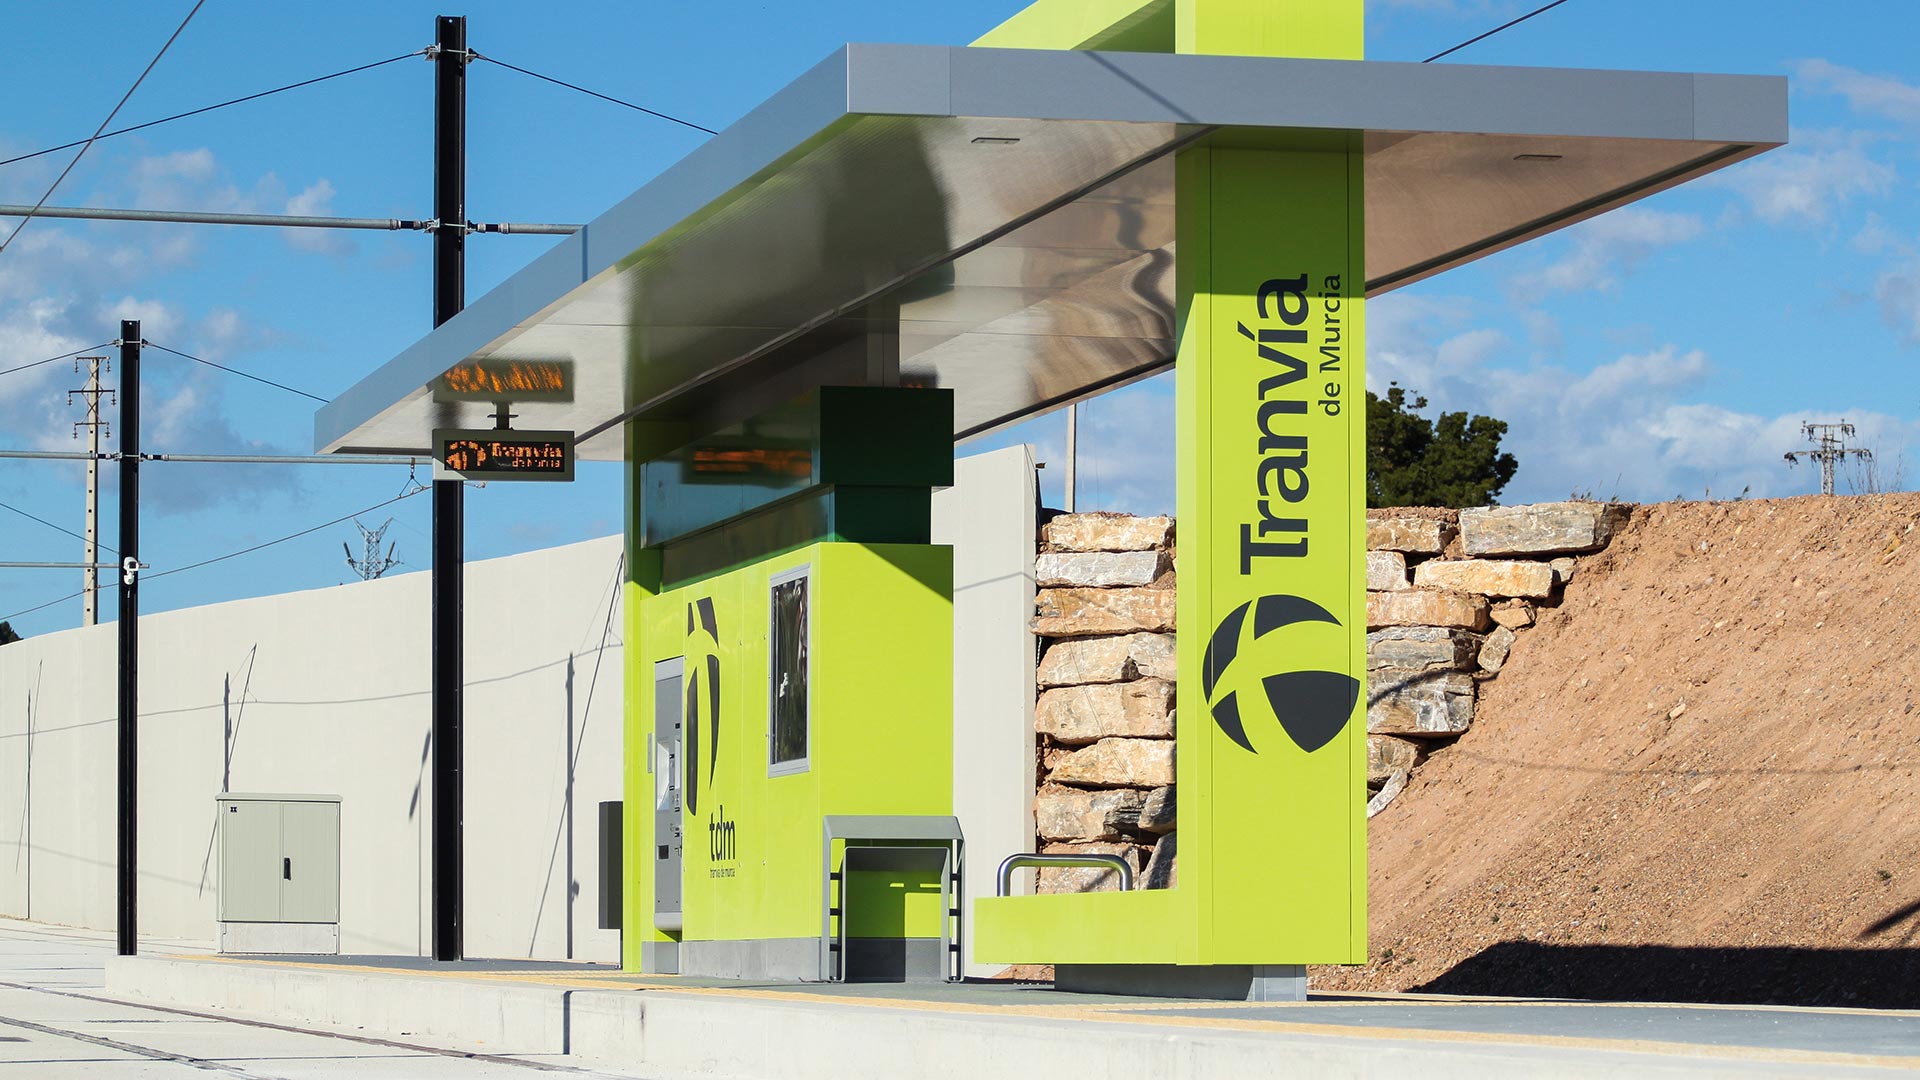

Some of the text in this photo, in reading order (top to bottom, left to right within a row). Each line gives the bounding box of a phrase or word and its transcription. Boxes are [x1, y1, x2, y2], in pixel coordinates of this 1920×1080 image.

[1318, 274, 1341, 417] de Murcia
[1237, 273, 1309, 575] Tranvía
[709, 804, 735, 861] tdm
